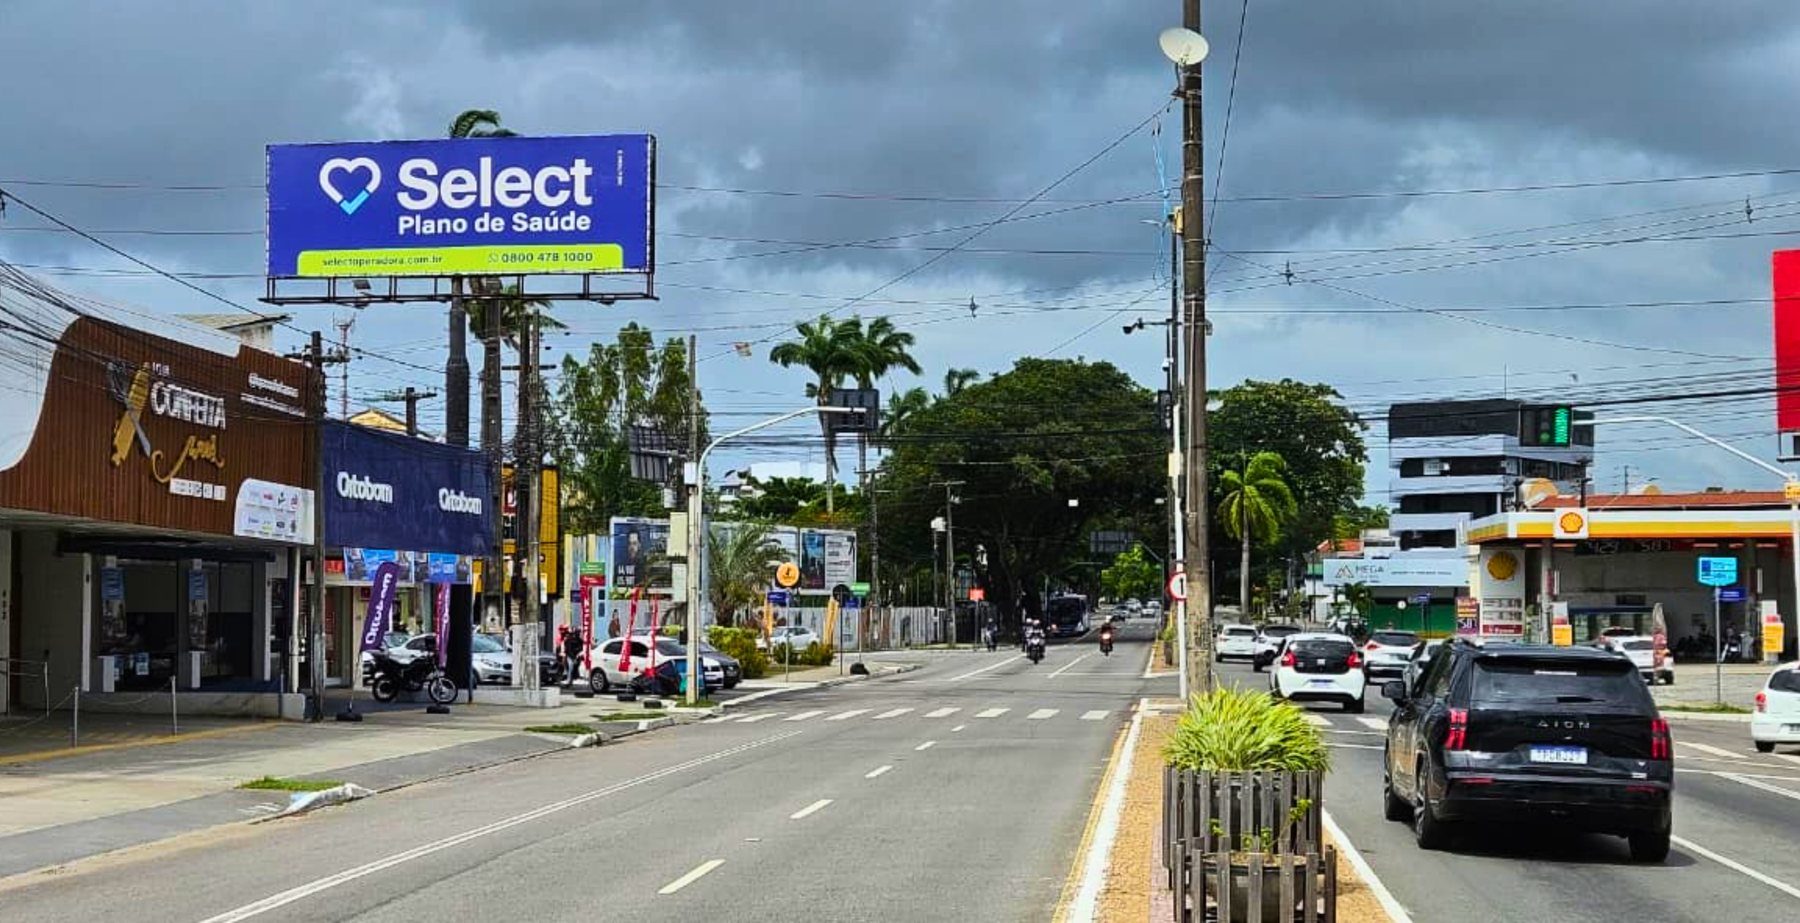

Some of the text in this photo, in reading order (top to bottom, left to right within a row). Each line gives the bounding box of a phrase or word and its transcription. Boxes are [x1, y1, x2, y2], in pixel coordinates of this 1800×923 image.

[396, 156, 593, 210] Select
[398, 210, 591, 235] Plano de Saúde
[322, 254, 443, 267] selectoperadora.com.br
[501, 251, 593, 263] 0800 478 1000
[336, 471, 394, 504] Ortobom
[438, 487, 482, 515] Ortobom
[1537, 720, 1590, 729] AION
